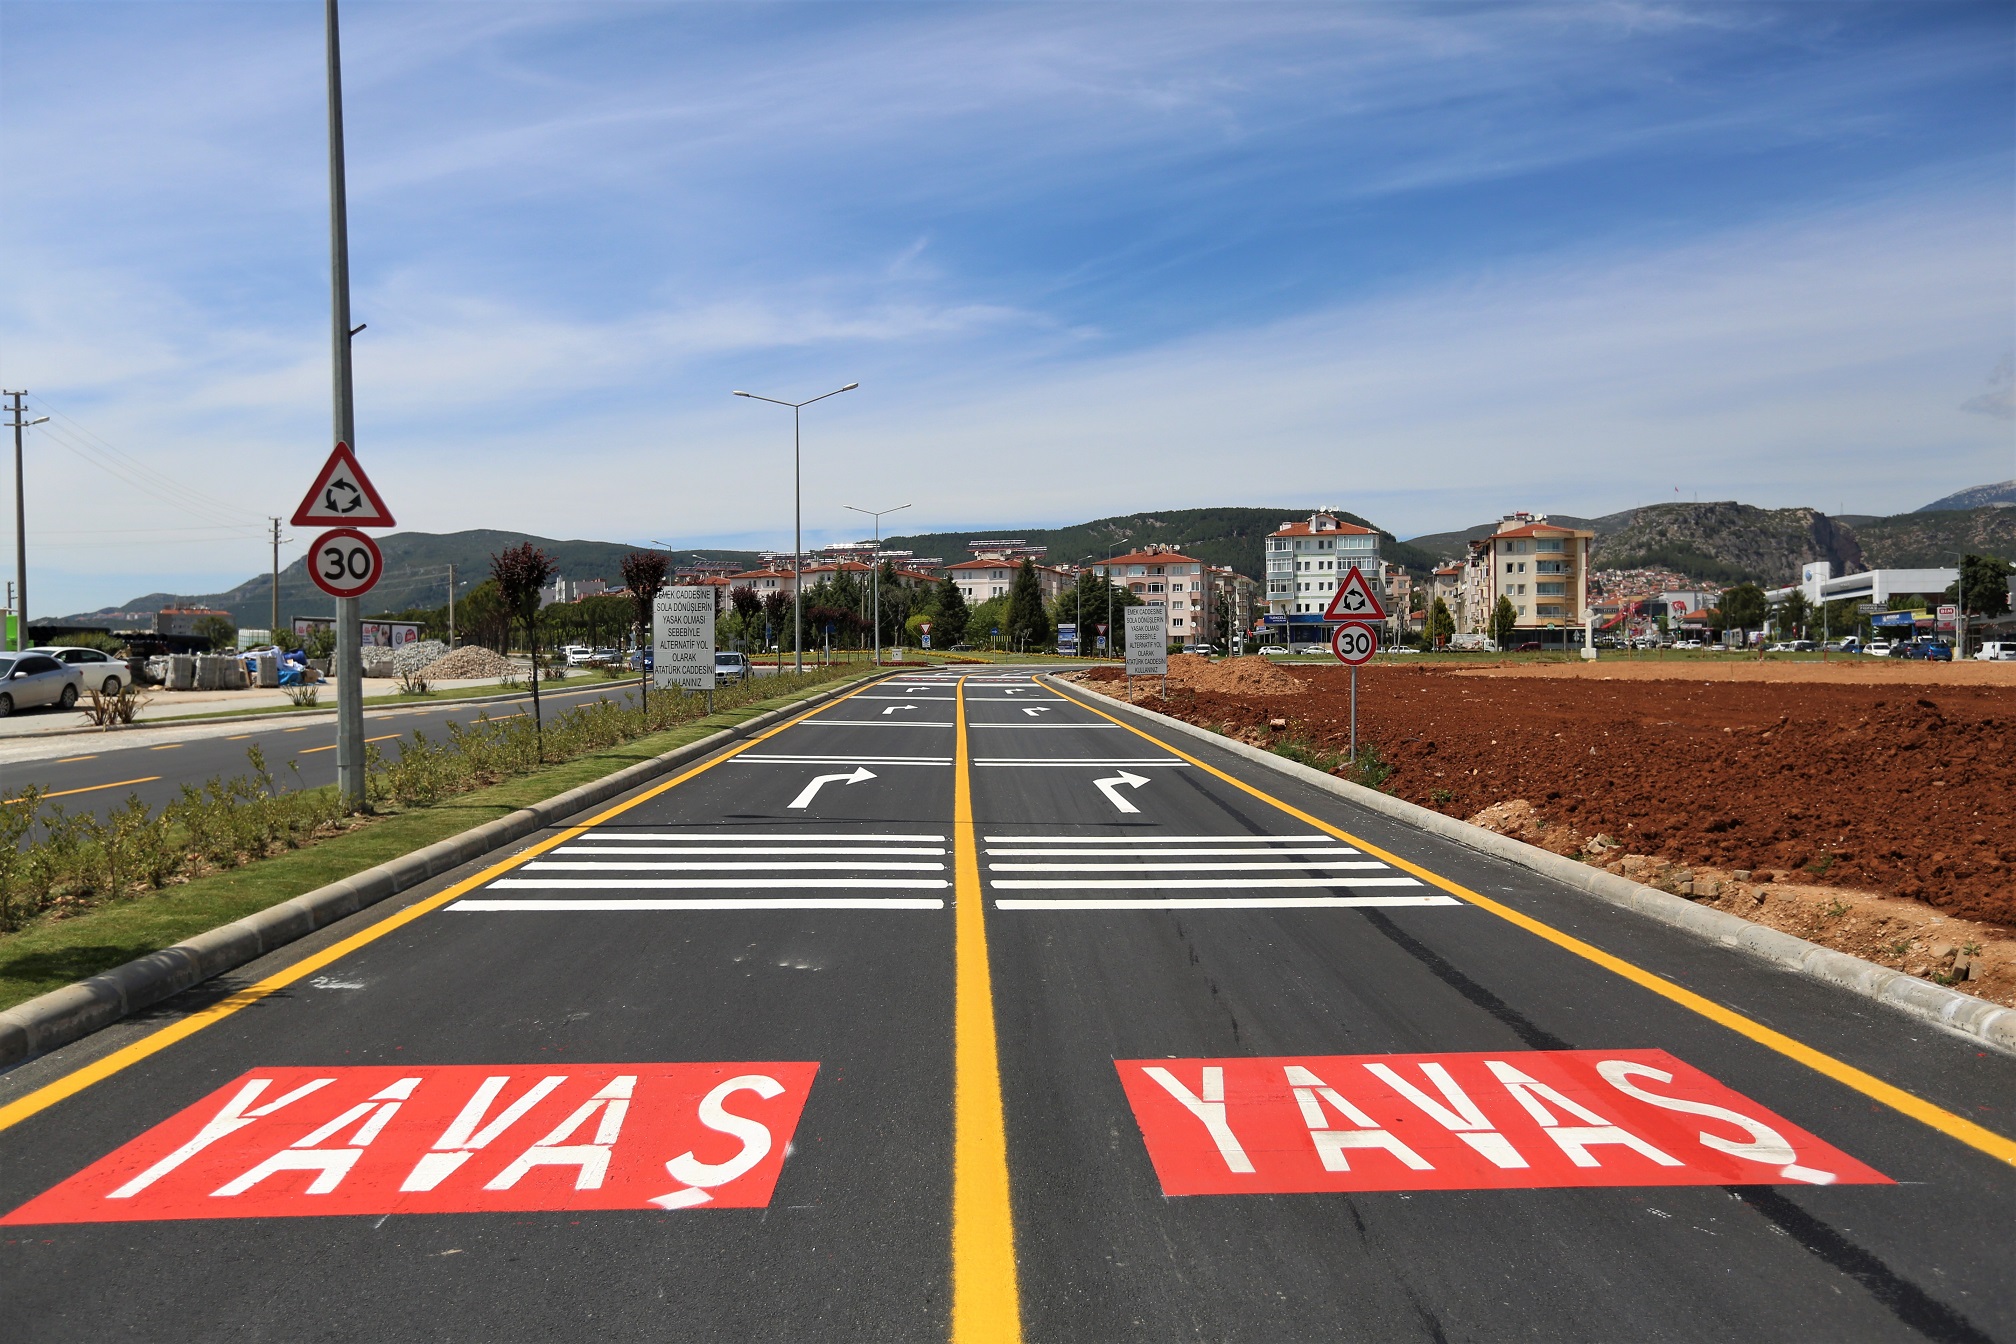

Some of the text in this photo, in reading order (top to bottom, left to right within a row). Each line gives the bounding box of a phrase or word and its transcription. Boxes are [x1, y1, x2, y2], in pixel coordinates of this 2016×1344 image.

[324, 547, 370, 580] 30
[676, 589, 710, 599] CADDESİNE
[656, 601, 712, 613] SOLA DÖNÜŞLERİN
[663, 615, 706, 624] YASAK OLMASI
[668, 626, 700, 637] SEBEBİYLE
[660, 639, 708, 650] ALTERNATİF YOL
[1342, 633, 1370, 654] 30
[672, 652, 696, 662] OLARAK
[654, 664, 714, 674] ATATÜRK CADDESİNİ
[1141, 1060, 1838, 1185] YAVAŞ
[105, 1074, 787, 1209] YAVAŞ
